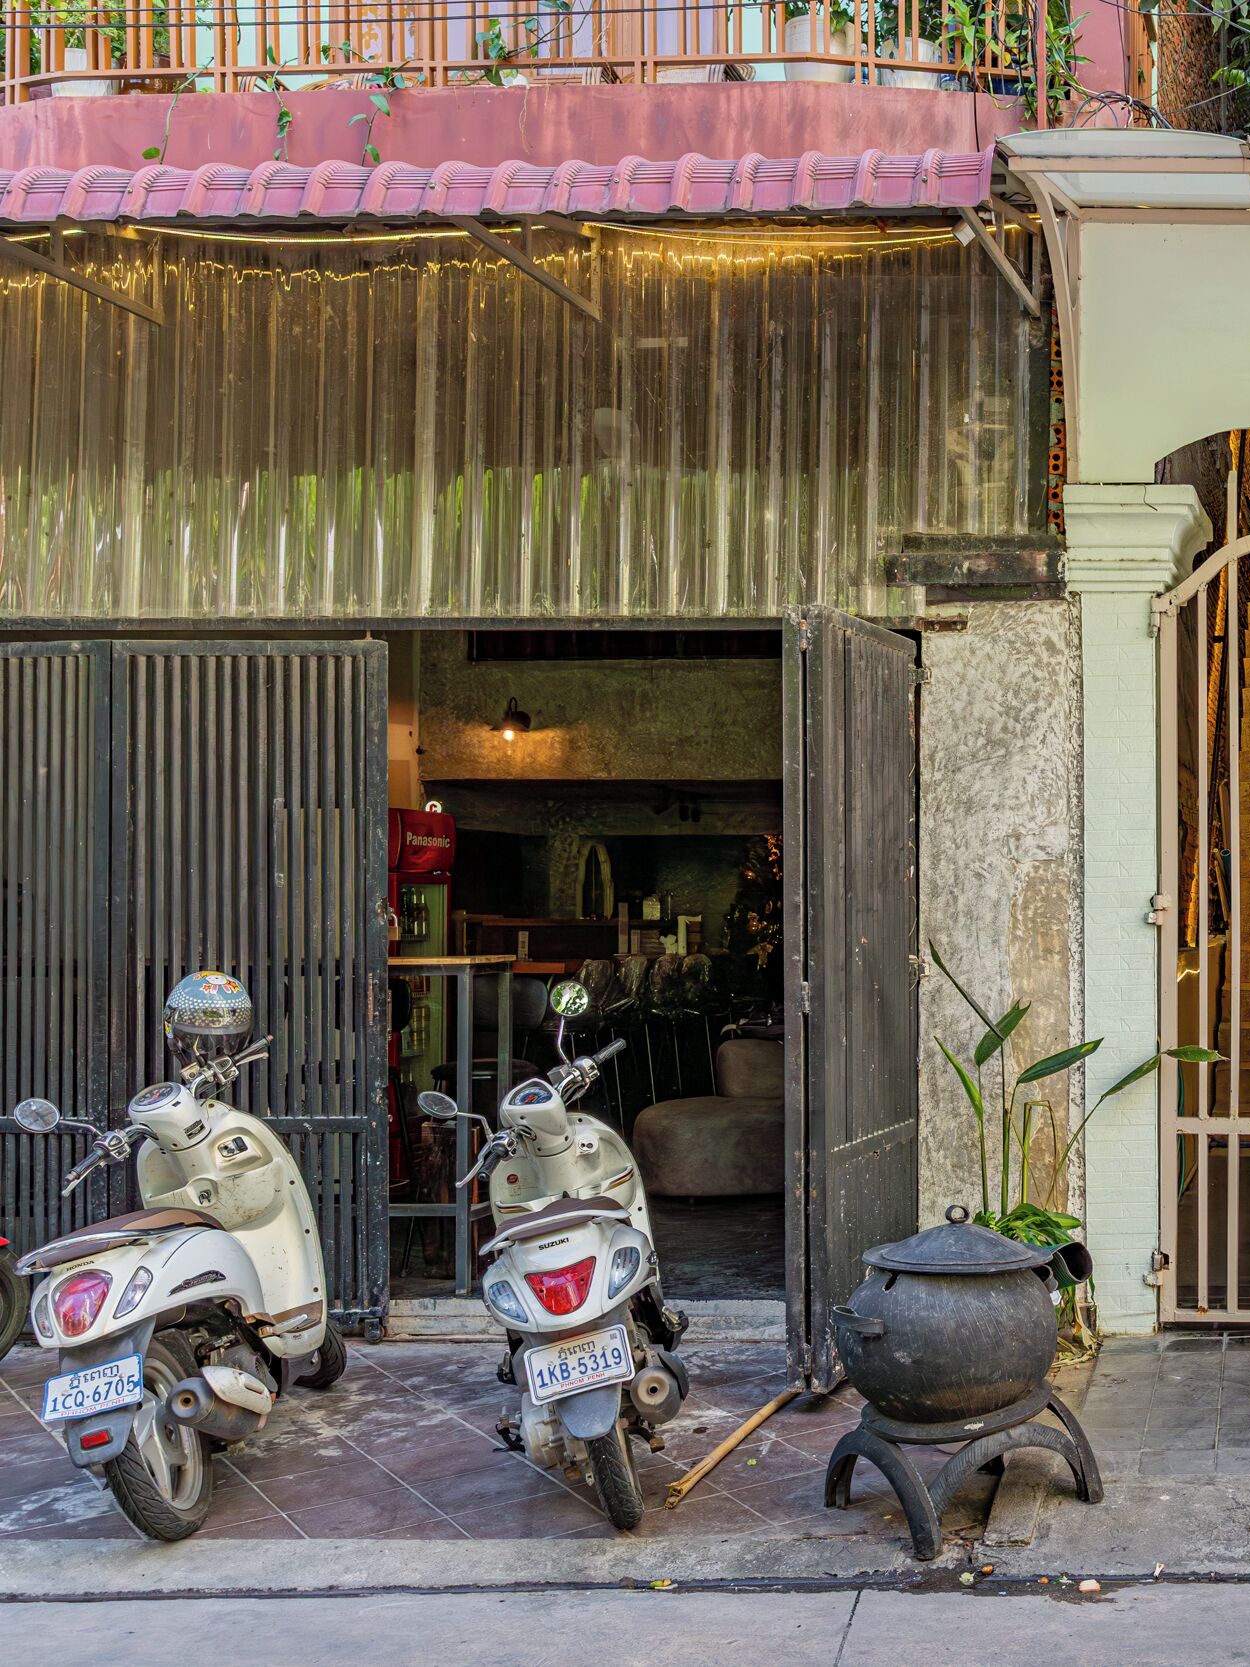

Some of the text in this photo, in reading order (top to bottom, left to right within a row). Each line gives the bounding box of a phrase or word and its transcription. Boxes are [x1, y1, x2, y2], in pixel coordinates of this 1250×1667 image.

[406, 831, 451, 848] Panasonic
[538, 1237, 570, 1251] SUZUKI
[66, 1260, 95, 1272] HONDA
[536, 1347, 622, 1389] 1KB-5319
[560, 1371, 606, 1389] PHNOM PENH
[49, 1374, 138, 1413] 1CQ-6705
[60, 1398, 125, 1417] PHNOM PENH
